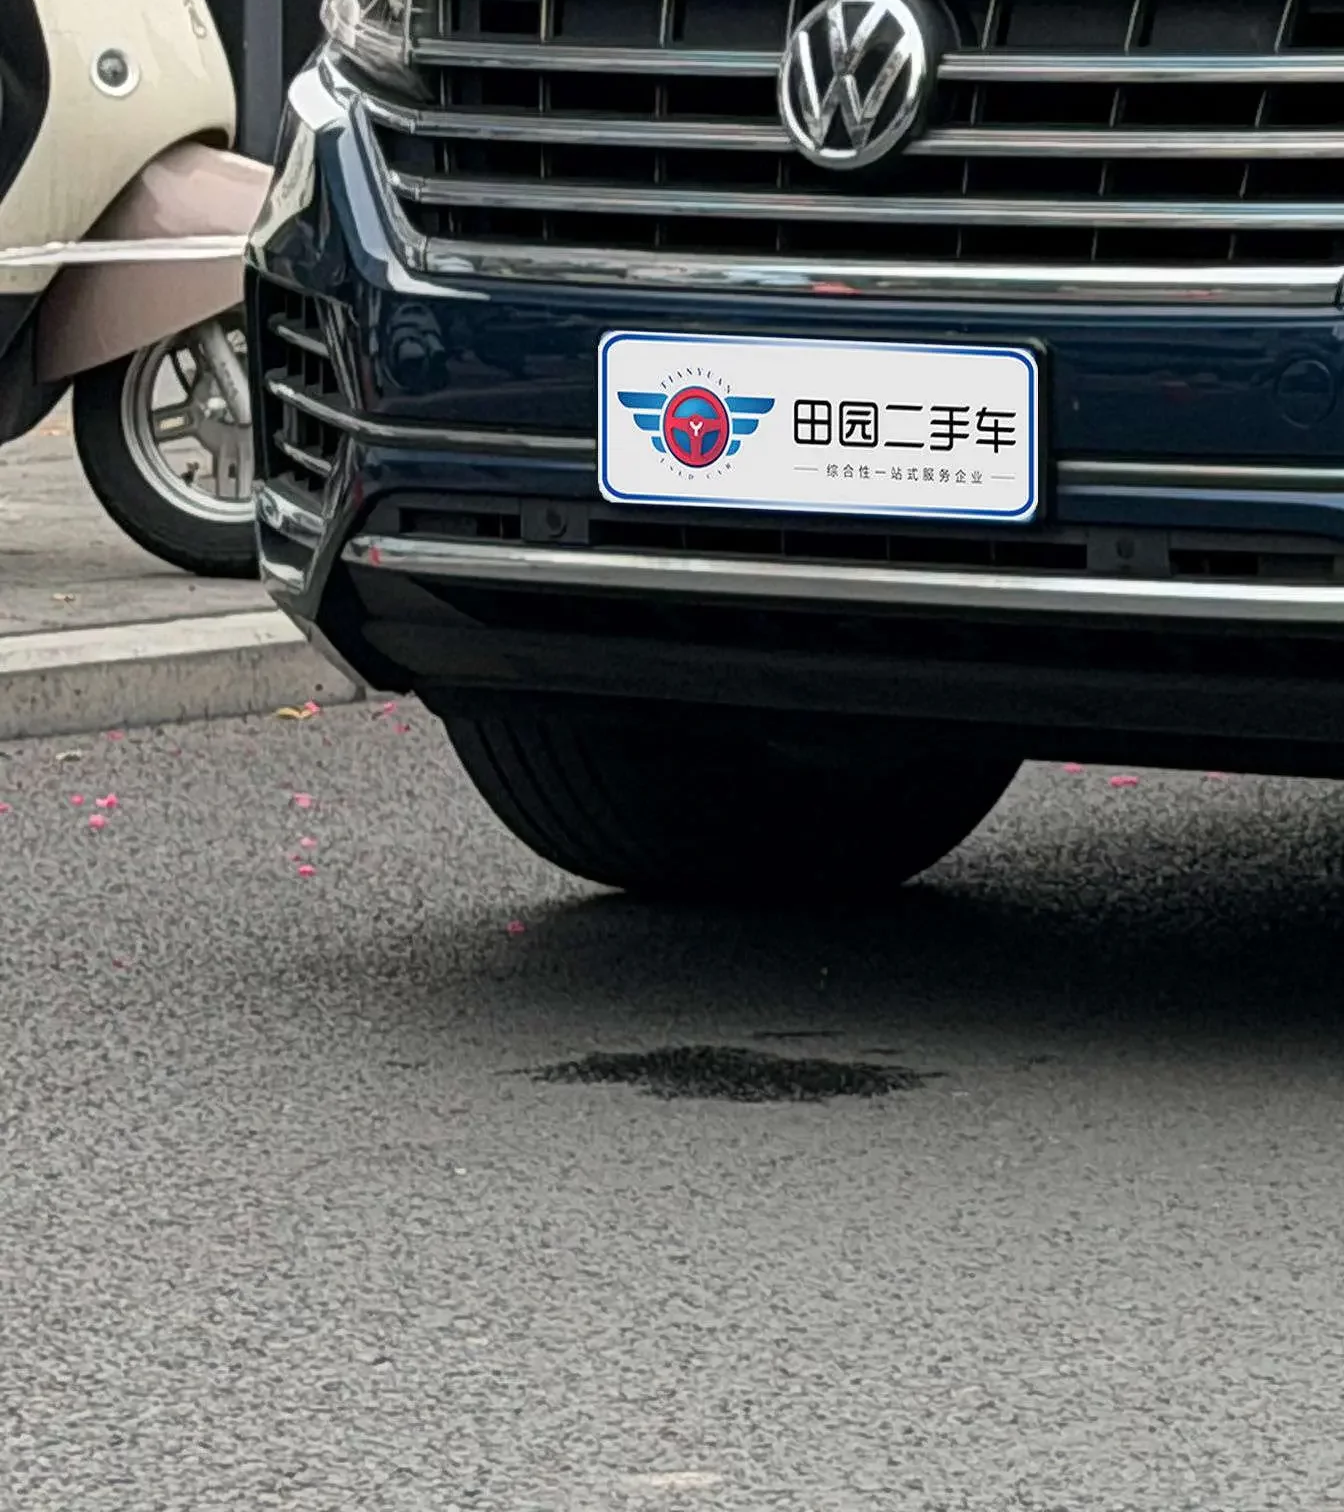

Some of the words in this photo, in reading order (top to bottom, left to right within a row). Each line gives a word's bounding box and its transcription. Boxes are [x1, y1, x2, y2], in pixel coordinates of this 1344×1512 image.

[793, 399, 1017, 454] 田园二手车
[826, 463, 983, 485] 综合性一站式服务企业
